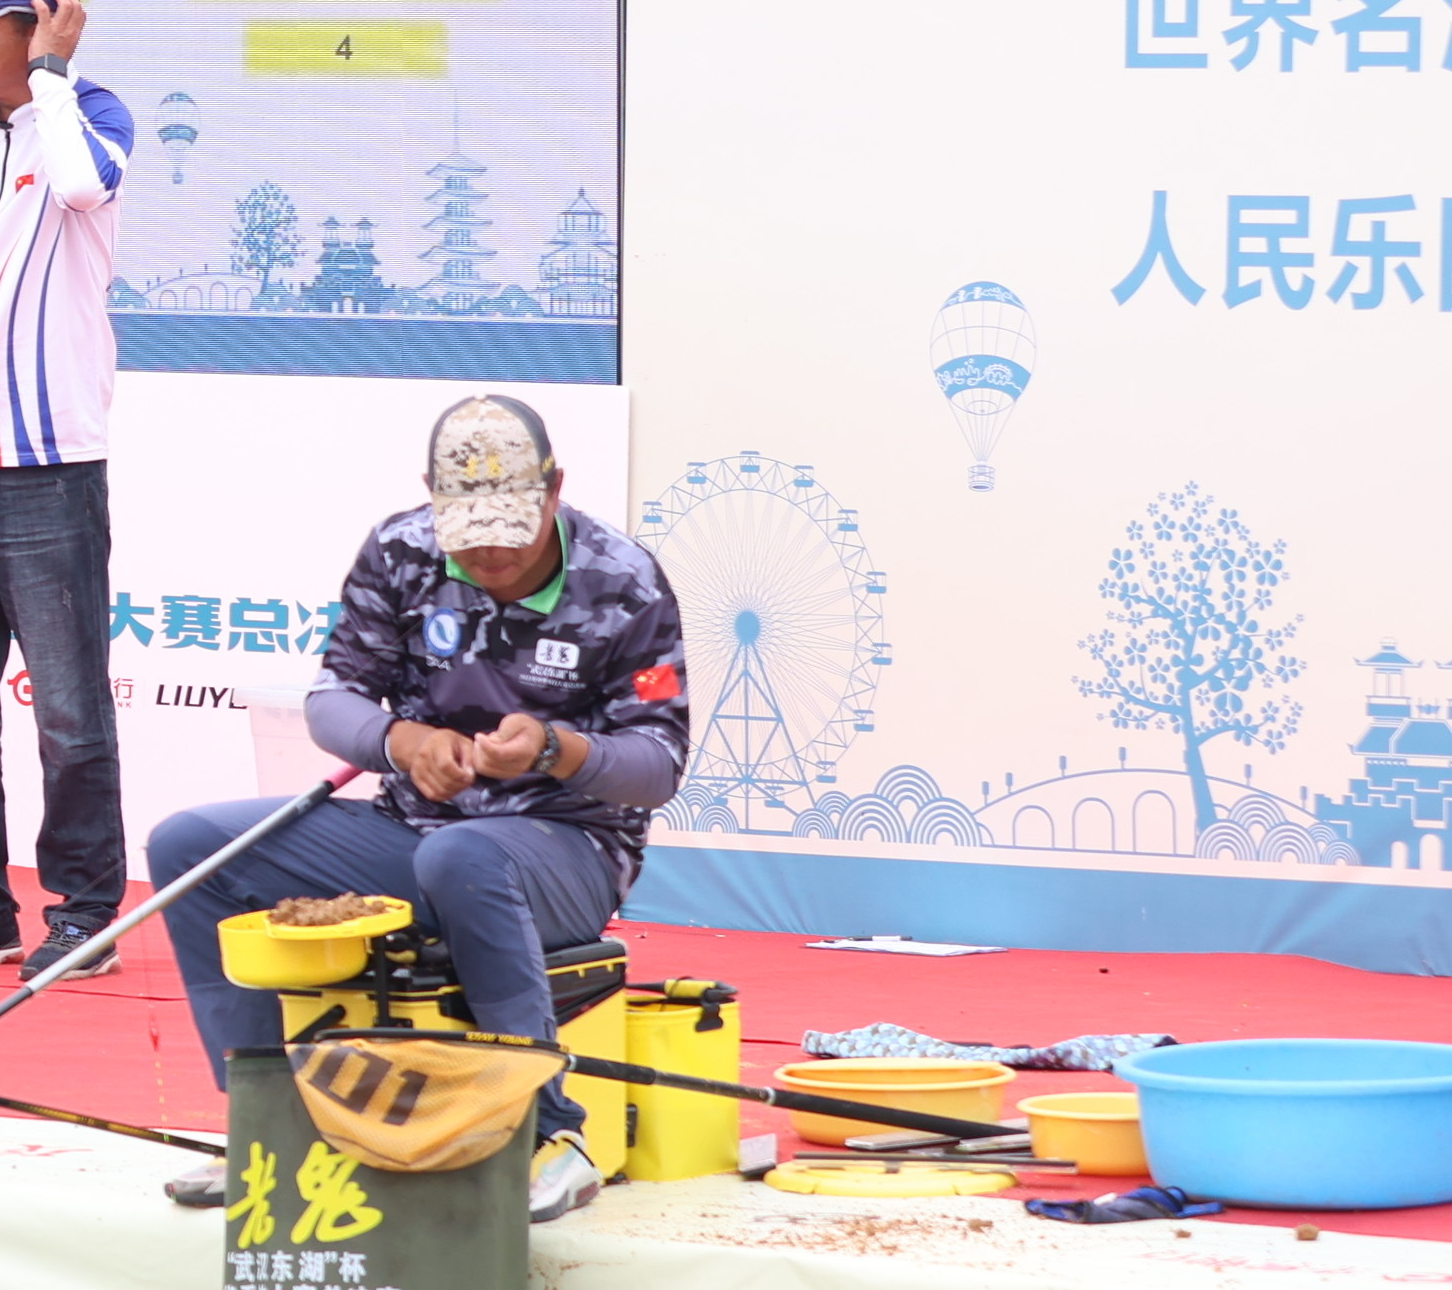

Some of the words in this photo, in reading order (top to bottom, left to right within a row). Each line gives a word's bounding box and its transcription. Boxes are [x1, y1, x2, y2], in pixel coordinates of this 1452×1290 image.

[335, 36, 353, 60] 4
[1110, 189, 1452, 313] 人民乐
